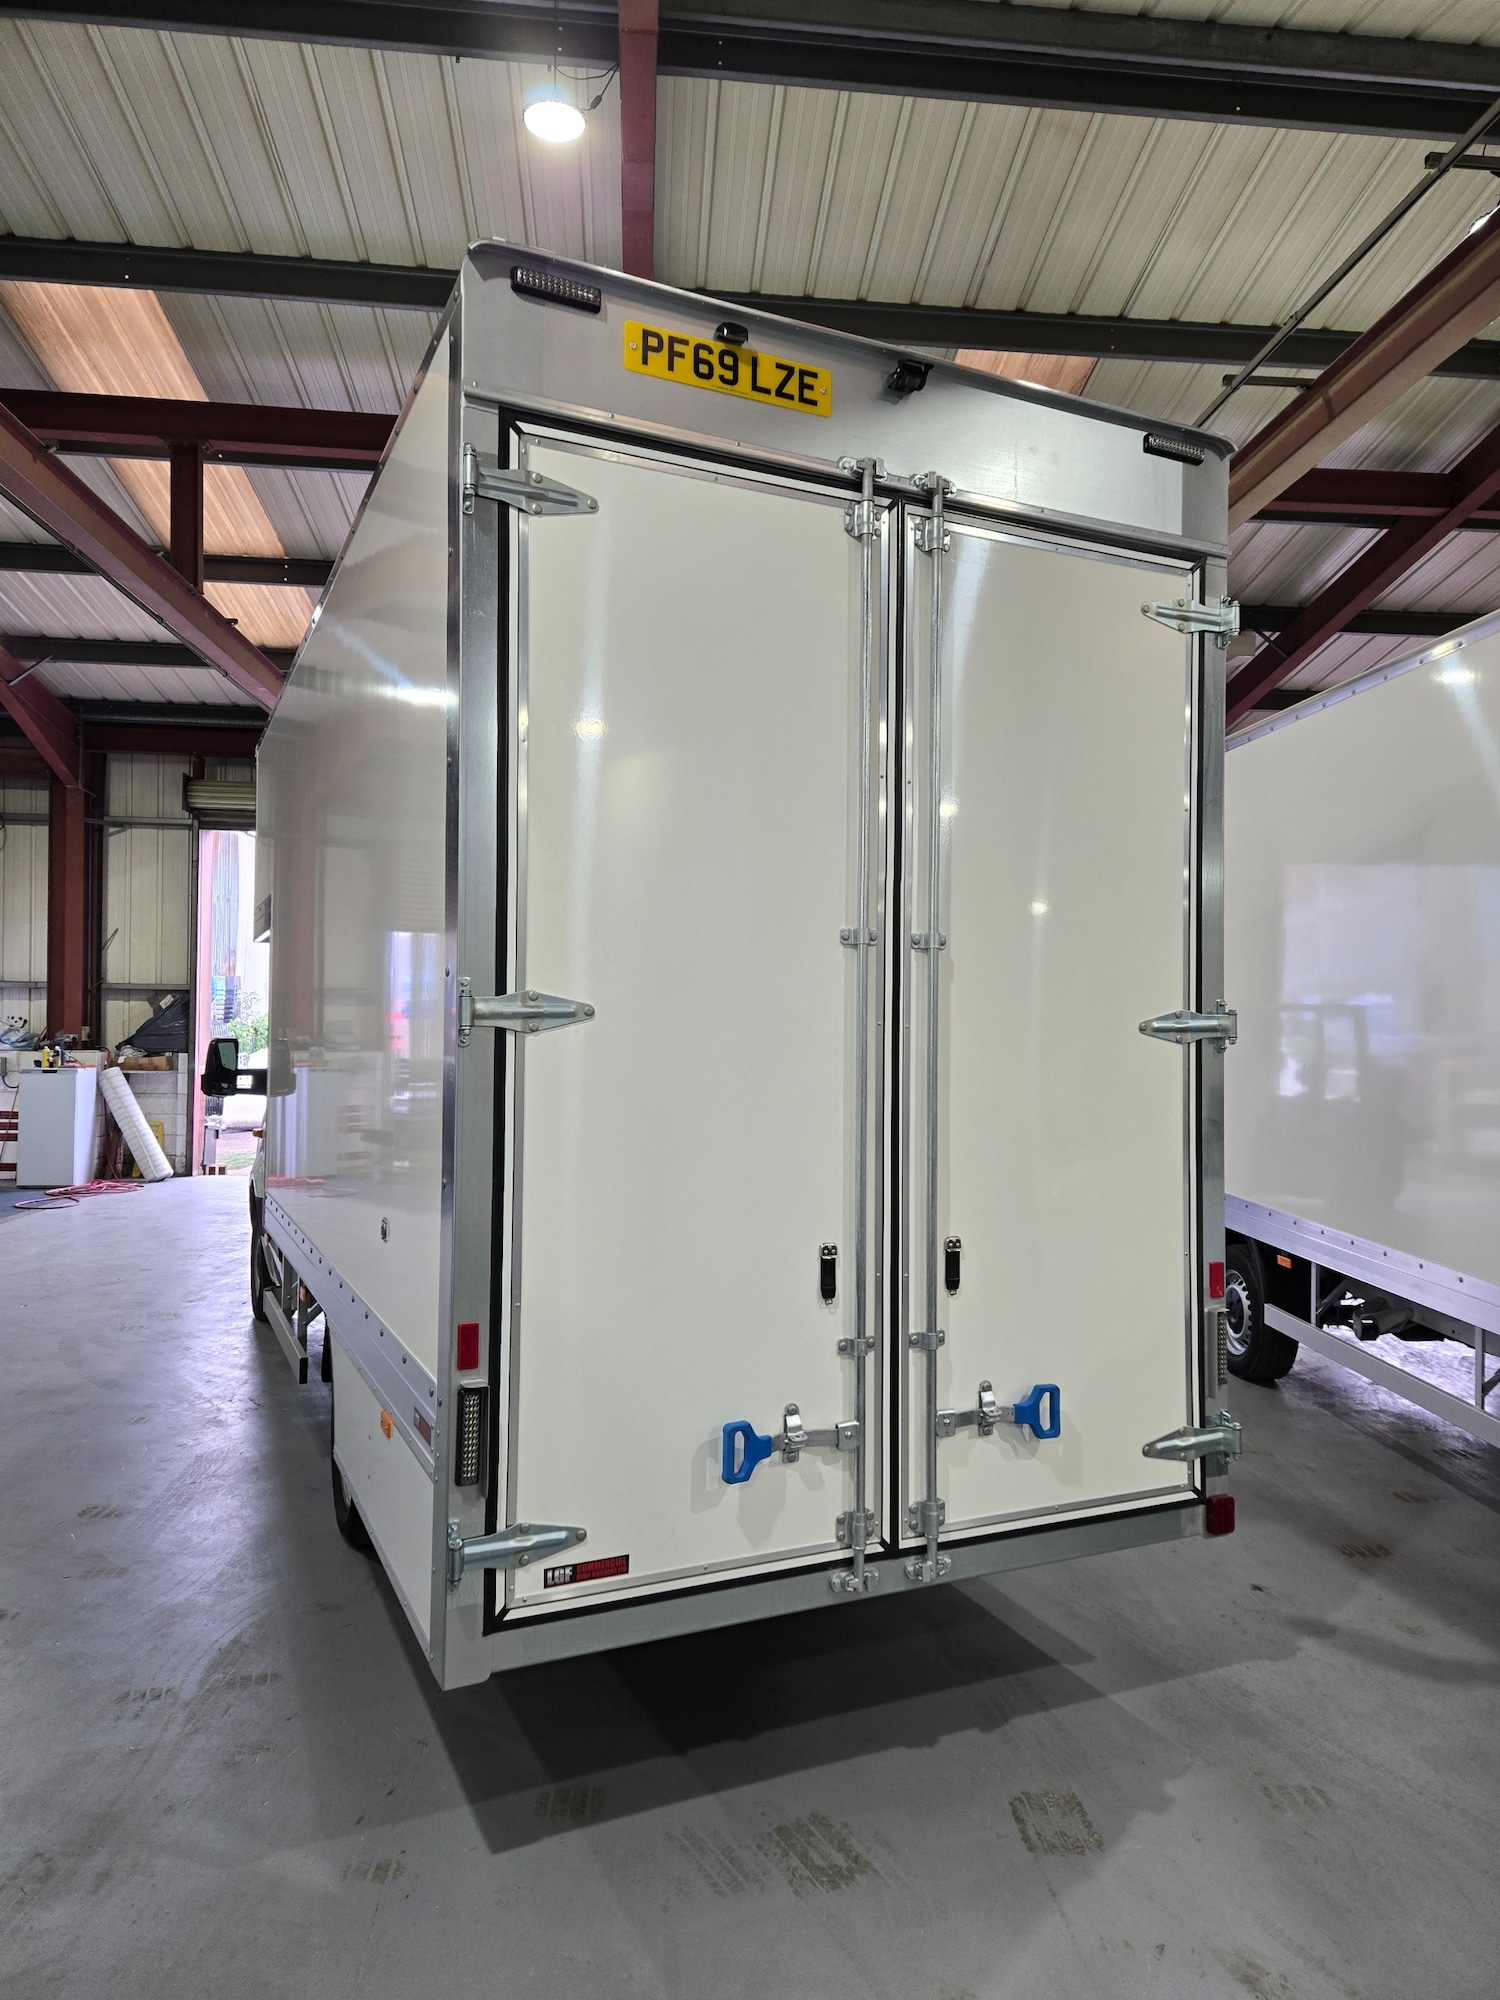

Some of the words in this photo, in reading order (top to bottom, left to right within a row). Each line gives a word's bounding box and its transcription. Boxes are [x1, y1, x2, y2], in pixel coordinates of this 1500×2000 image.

[642, 328, 738, 386] PF69
[752, 356, 818, 407] LZE
[547, 1566, 573, 1587] LGF
